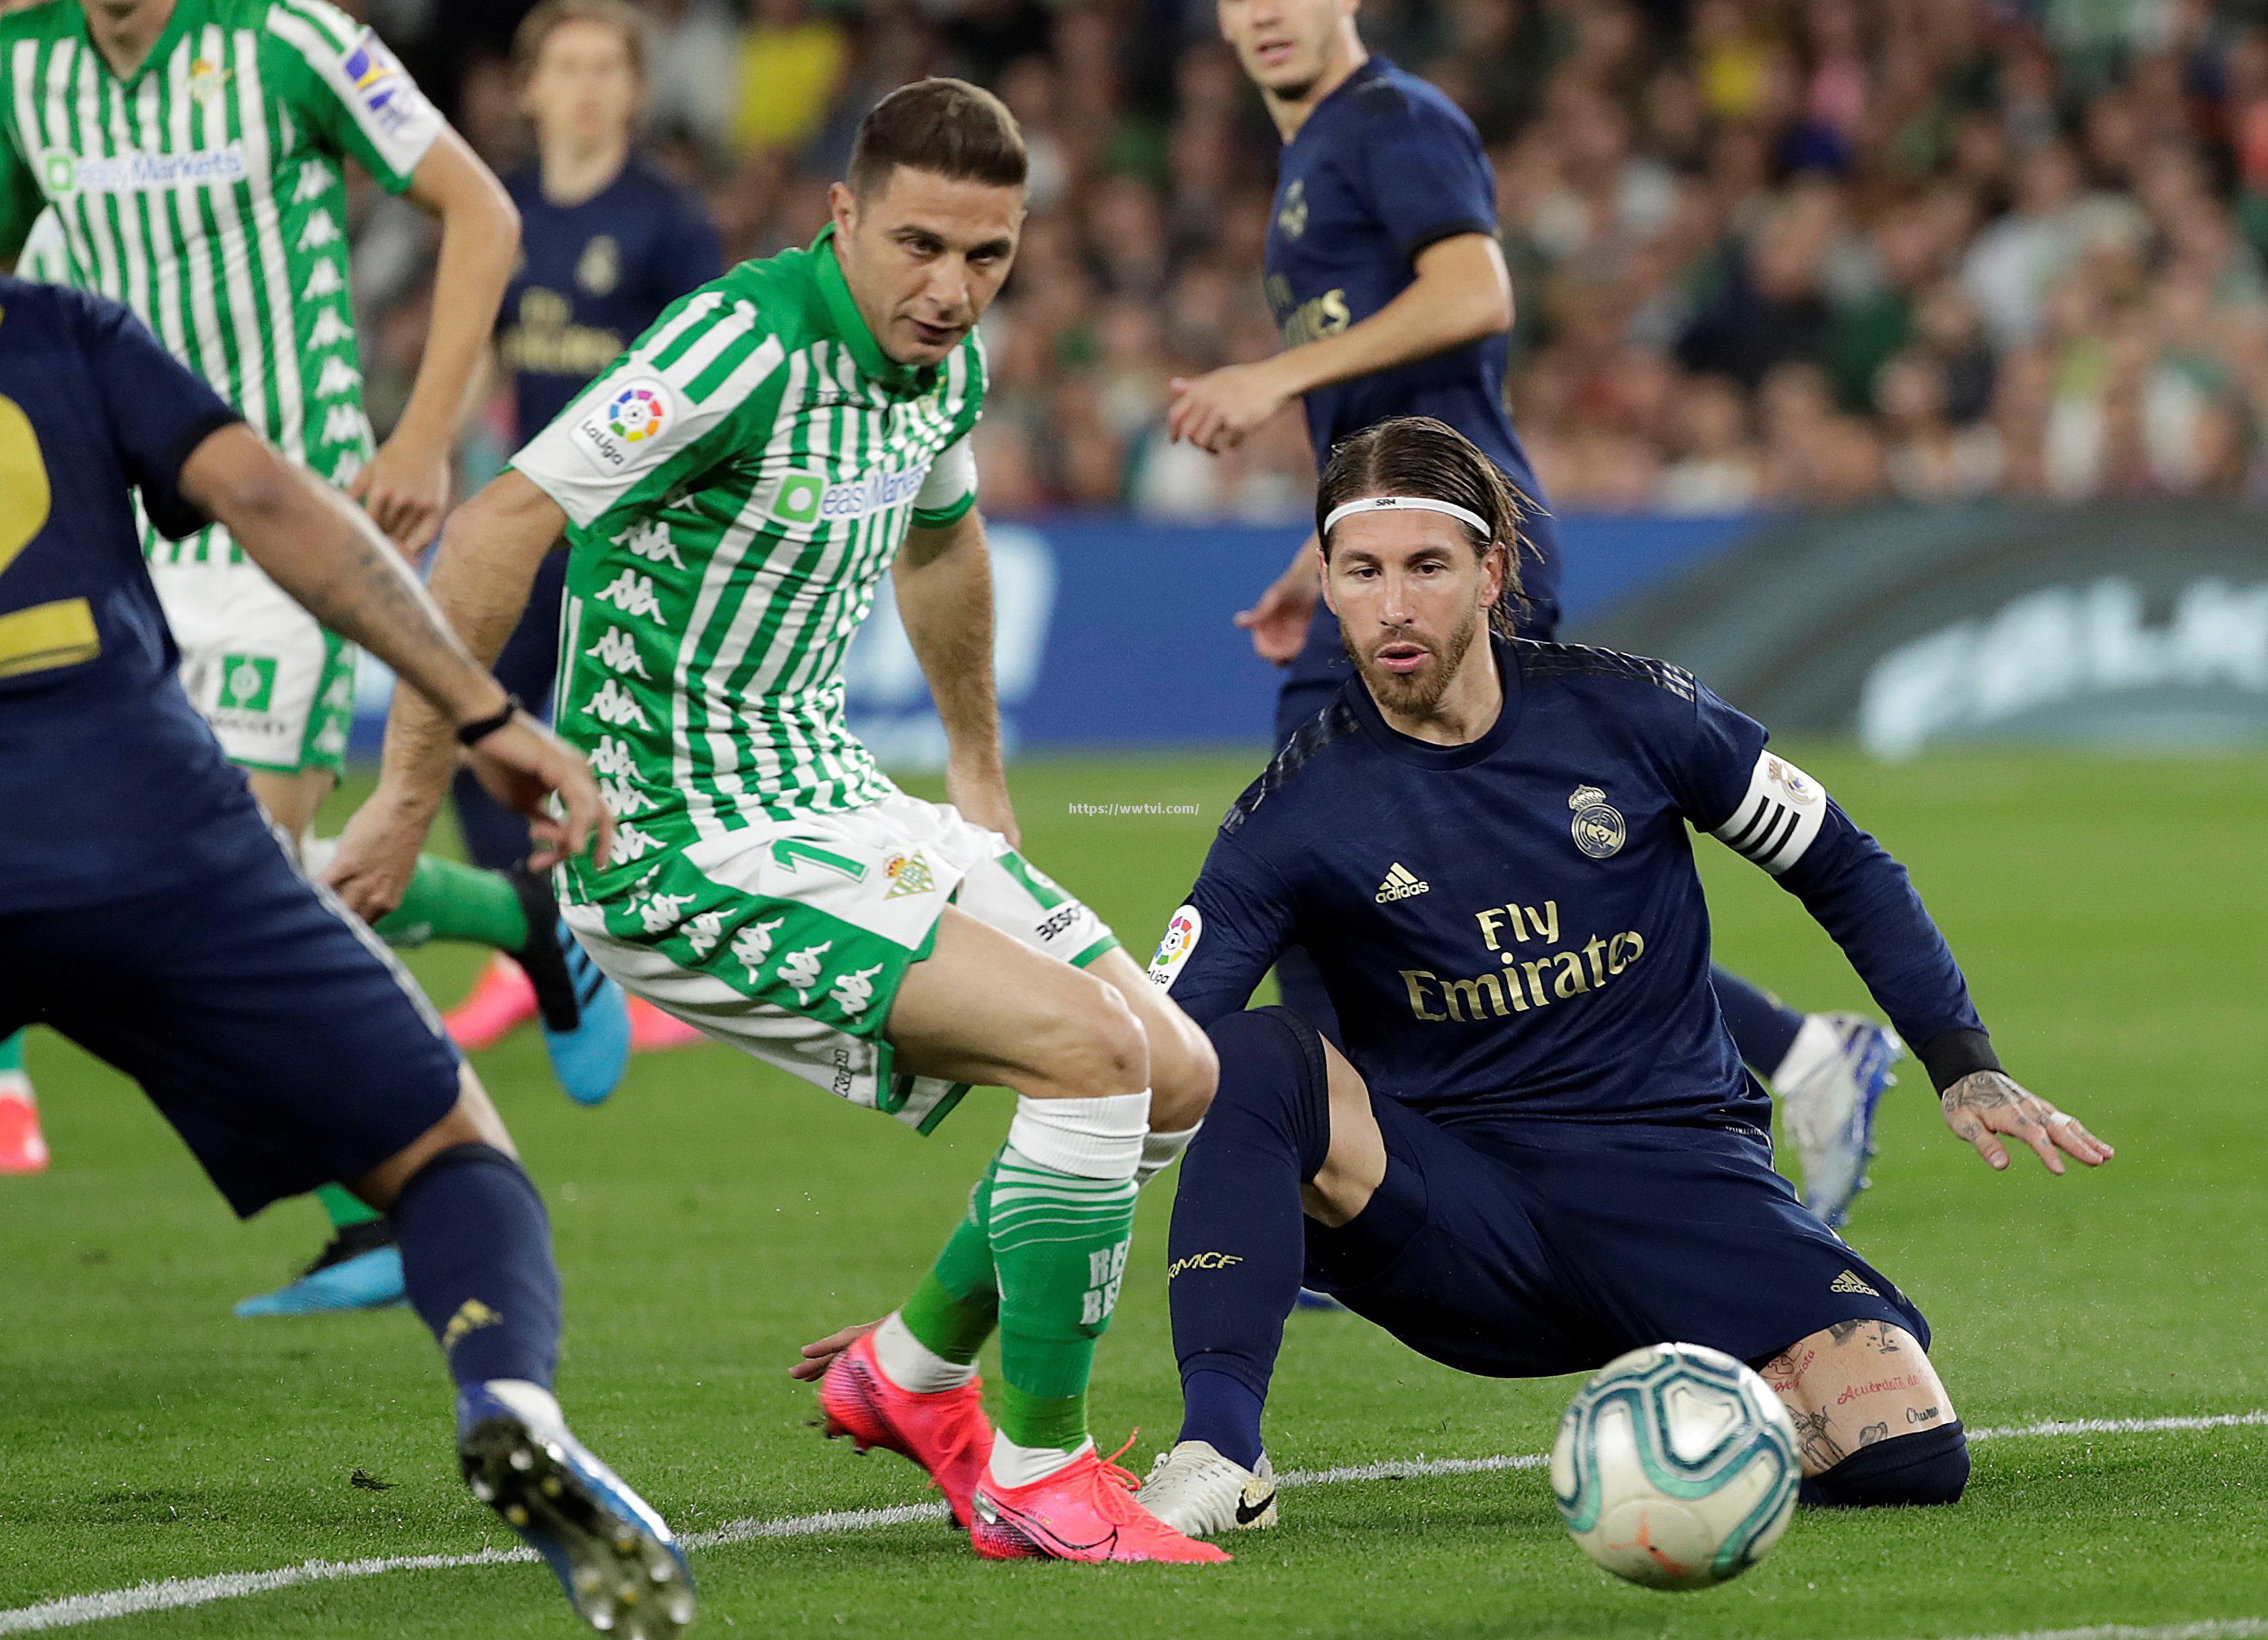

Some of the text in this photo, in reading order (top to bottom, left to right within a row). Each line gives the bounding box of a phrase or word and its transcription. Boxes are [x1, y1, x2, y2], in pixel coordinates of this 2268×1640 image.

[581, 419, 624, 465] LaLiga
[1375, 881, 1430, 903] adidas
[1475, 900, 1560, 951] Fly
[1147, 969, 1170, 985] Liga
[1398, 930, 1644, 1022] Emirates
[1167, 1252, 1244, 1287] RMCF
[1830, 1282, 1880, 1297] adidas
